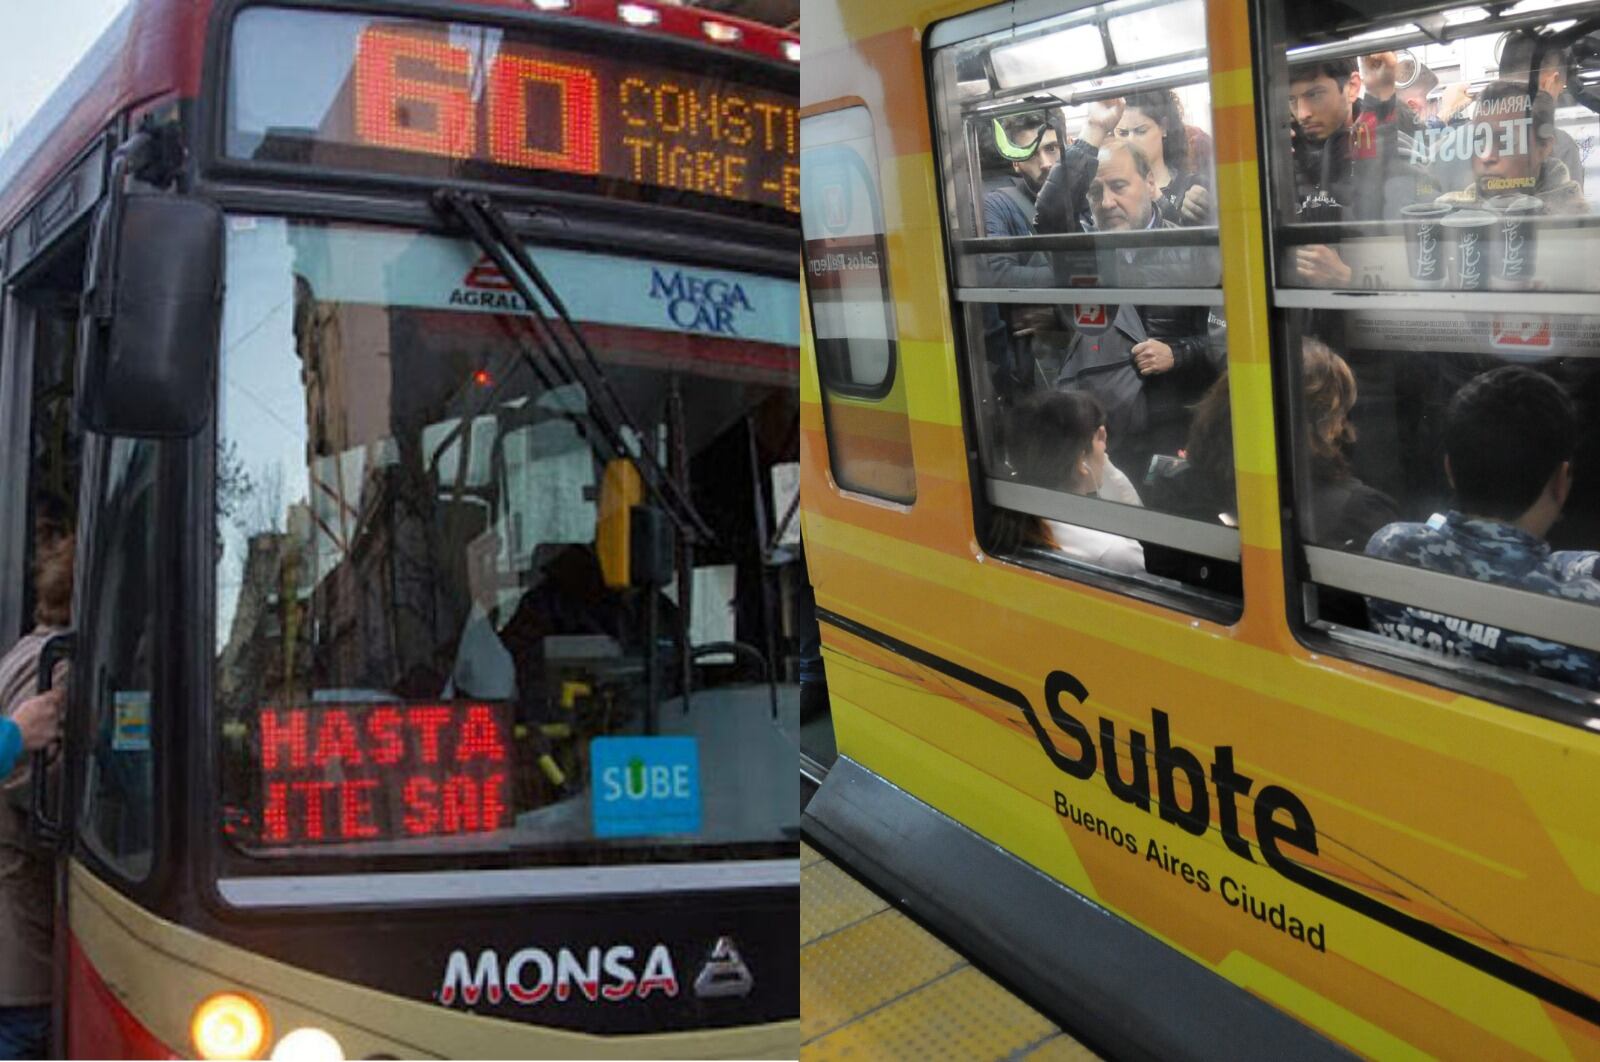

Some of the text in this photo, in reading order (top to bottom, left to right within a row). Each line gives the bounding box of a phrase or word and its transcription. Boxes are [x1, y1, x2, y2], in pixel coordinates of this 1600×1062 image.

[354, 26, 600, 176] 60
[619, 77, 800, 155] CONSTI
[449, 288, 535, 311] AGRAL
[648, 266, 755, 312] MEGA
[667, 299, 737, 334] CAR
[260, 703, 506, 770] HASTA
[602, 758, 691, 802] SUBE
[1043, 669, 1320, 878] Subte
[1054, 790, 1326, 953] Buenos Aires Ciudad
[440, 943, 680, 1005] MONSA
